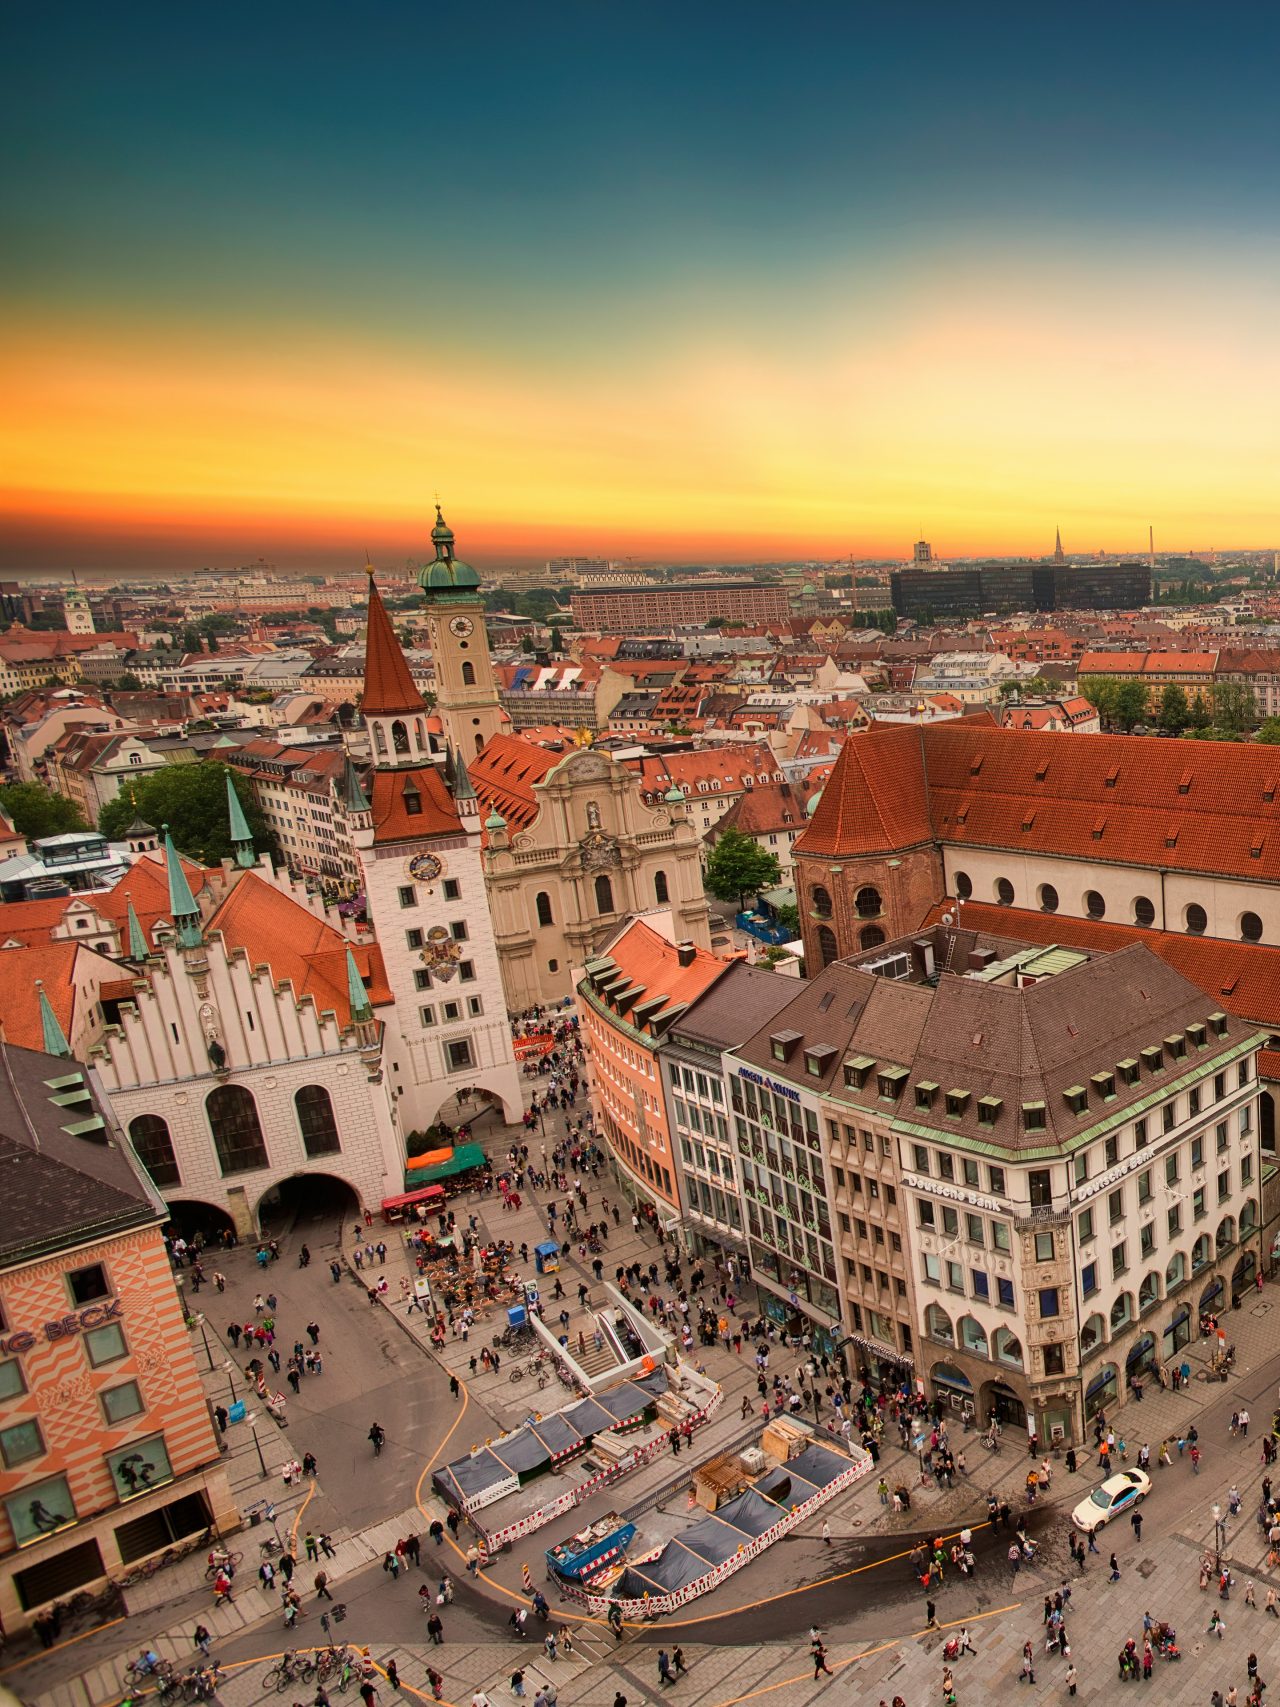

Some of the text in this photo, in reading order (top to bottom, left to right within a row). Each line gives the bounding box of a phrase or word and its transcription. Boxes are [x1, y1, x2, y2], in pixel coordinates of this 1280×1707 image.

[908, 1175, 1001, 1212] Deutsche Bank
[1077, 1148, 1156, 1201] Deutsche Bank
[45, 1299, 124, 1341] BECK
